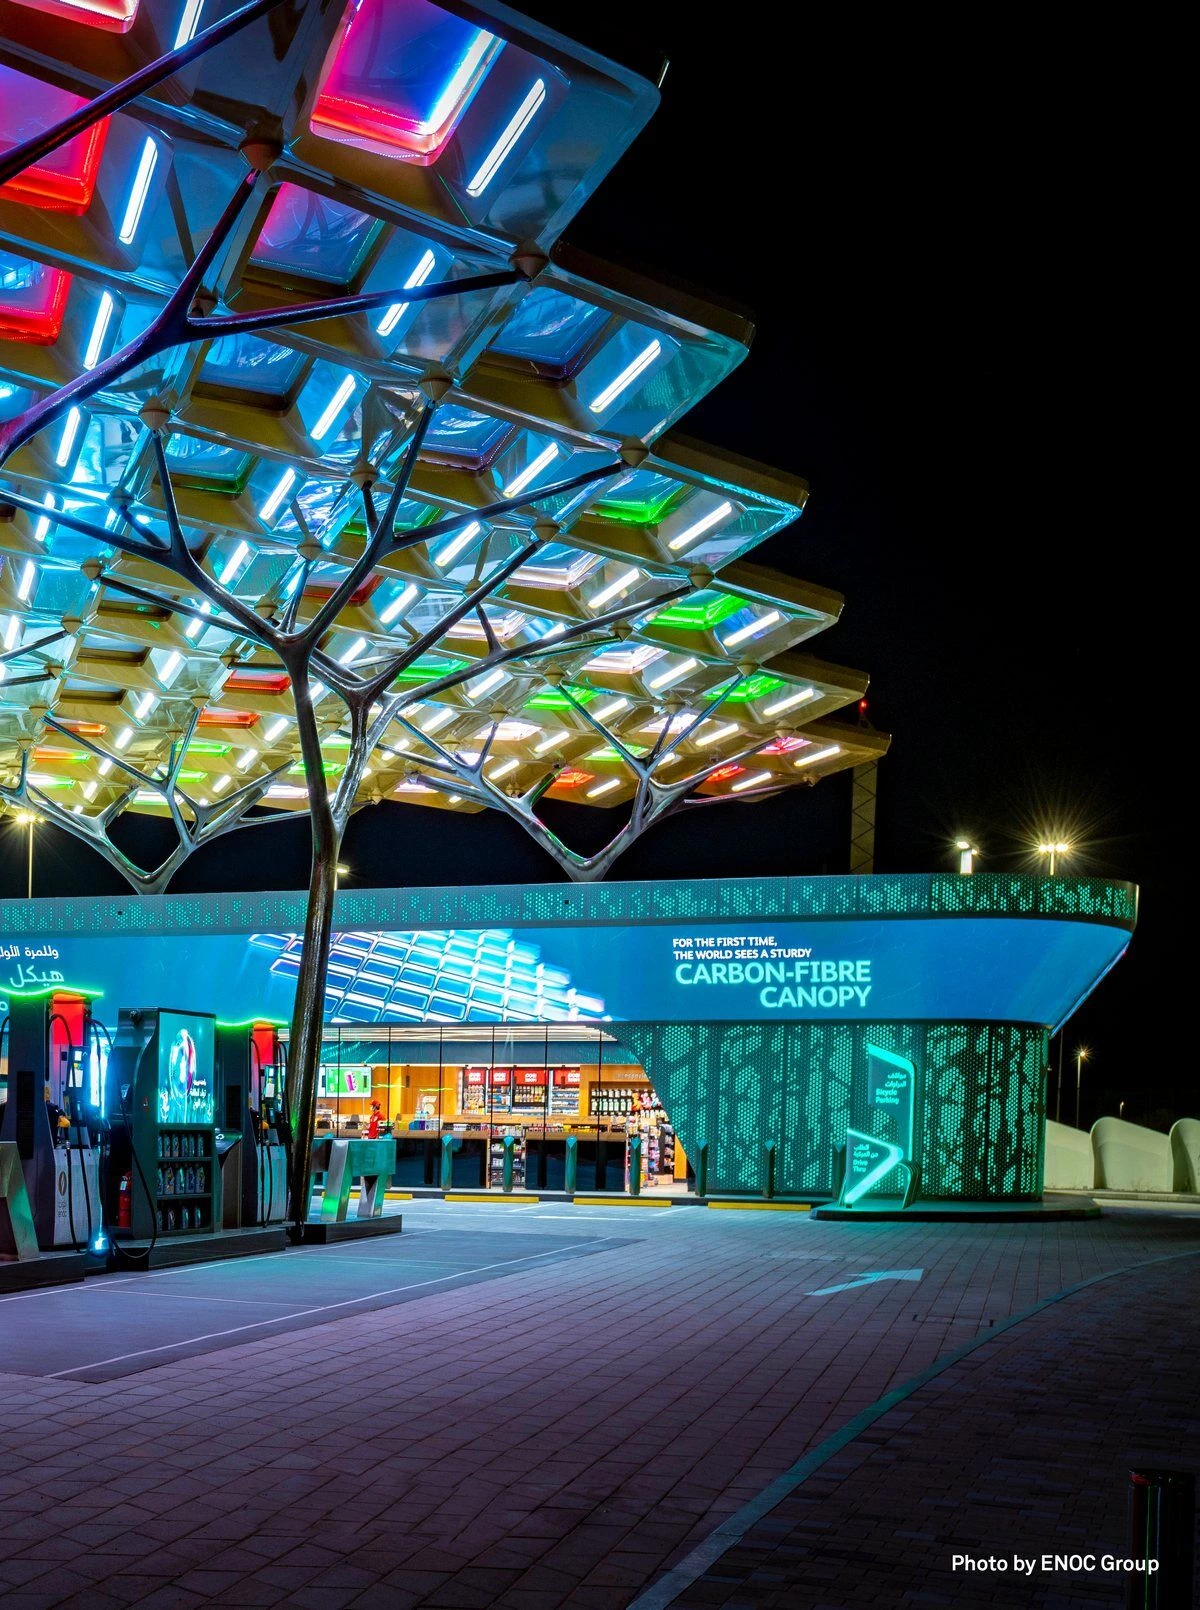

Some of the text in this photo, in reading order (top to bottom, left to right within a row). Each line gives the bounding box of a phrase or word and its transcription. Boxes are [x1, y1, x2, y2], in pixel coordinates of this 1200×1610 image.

[673, 936, 778, 948] FOR THE FIRST TIME,
[25, 945, 59, 959] وللمرة
[673, 948, 812, 960] THE WORLD SEES A STURDY
[9, 964, 65, 988] هيكل
[675, 960, 871, 985] CARBON-FIBRE
[759, 985, 872, 1008] CANOPY
[875, 1088, 898, 1097] Bicycle
[875, 1096, 900, 1105] Parking
[852, 1165, 867, 1173] Thru
